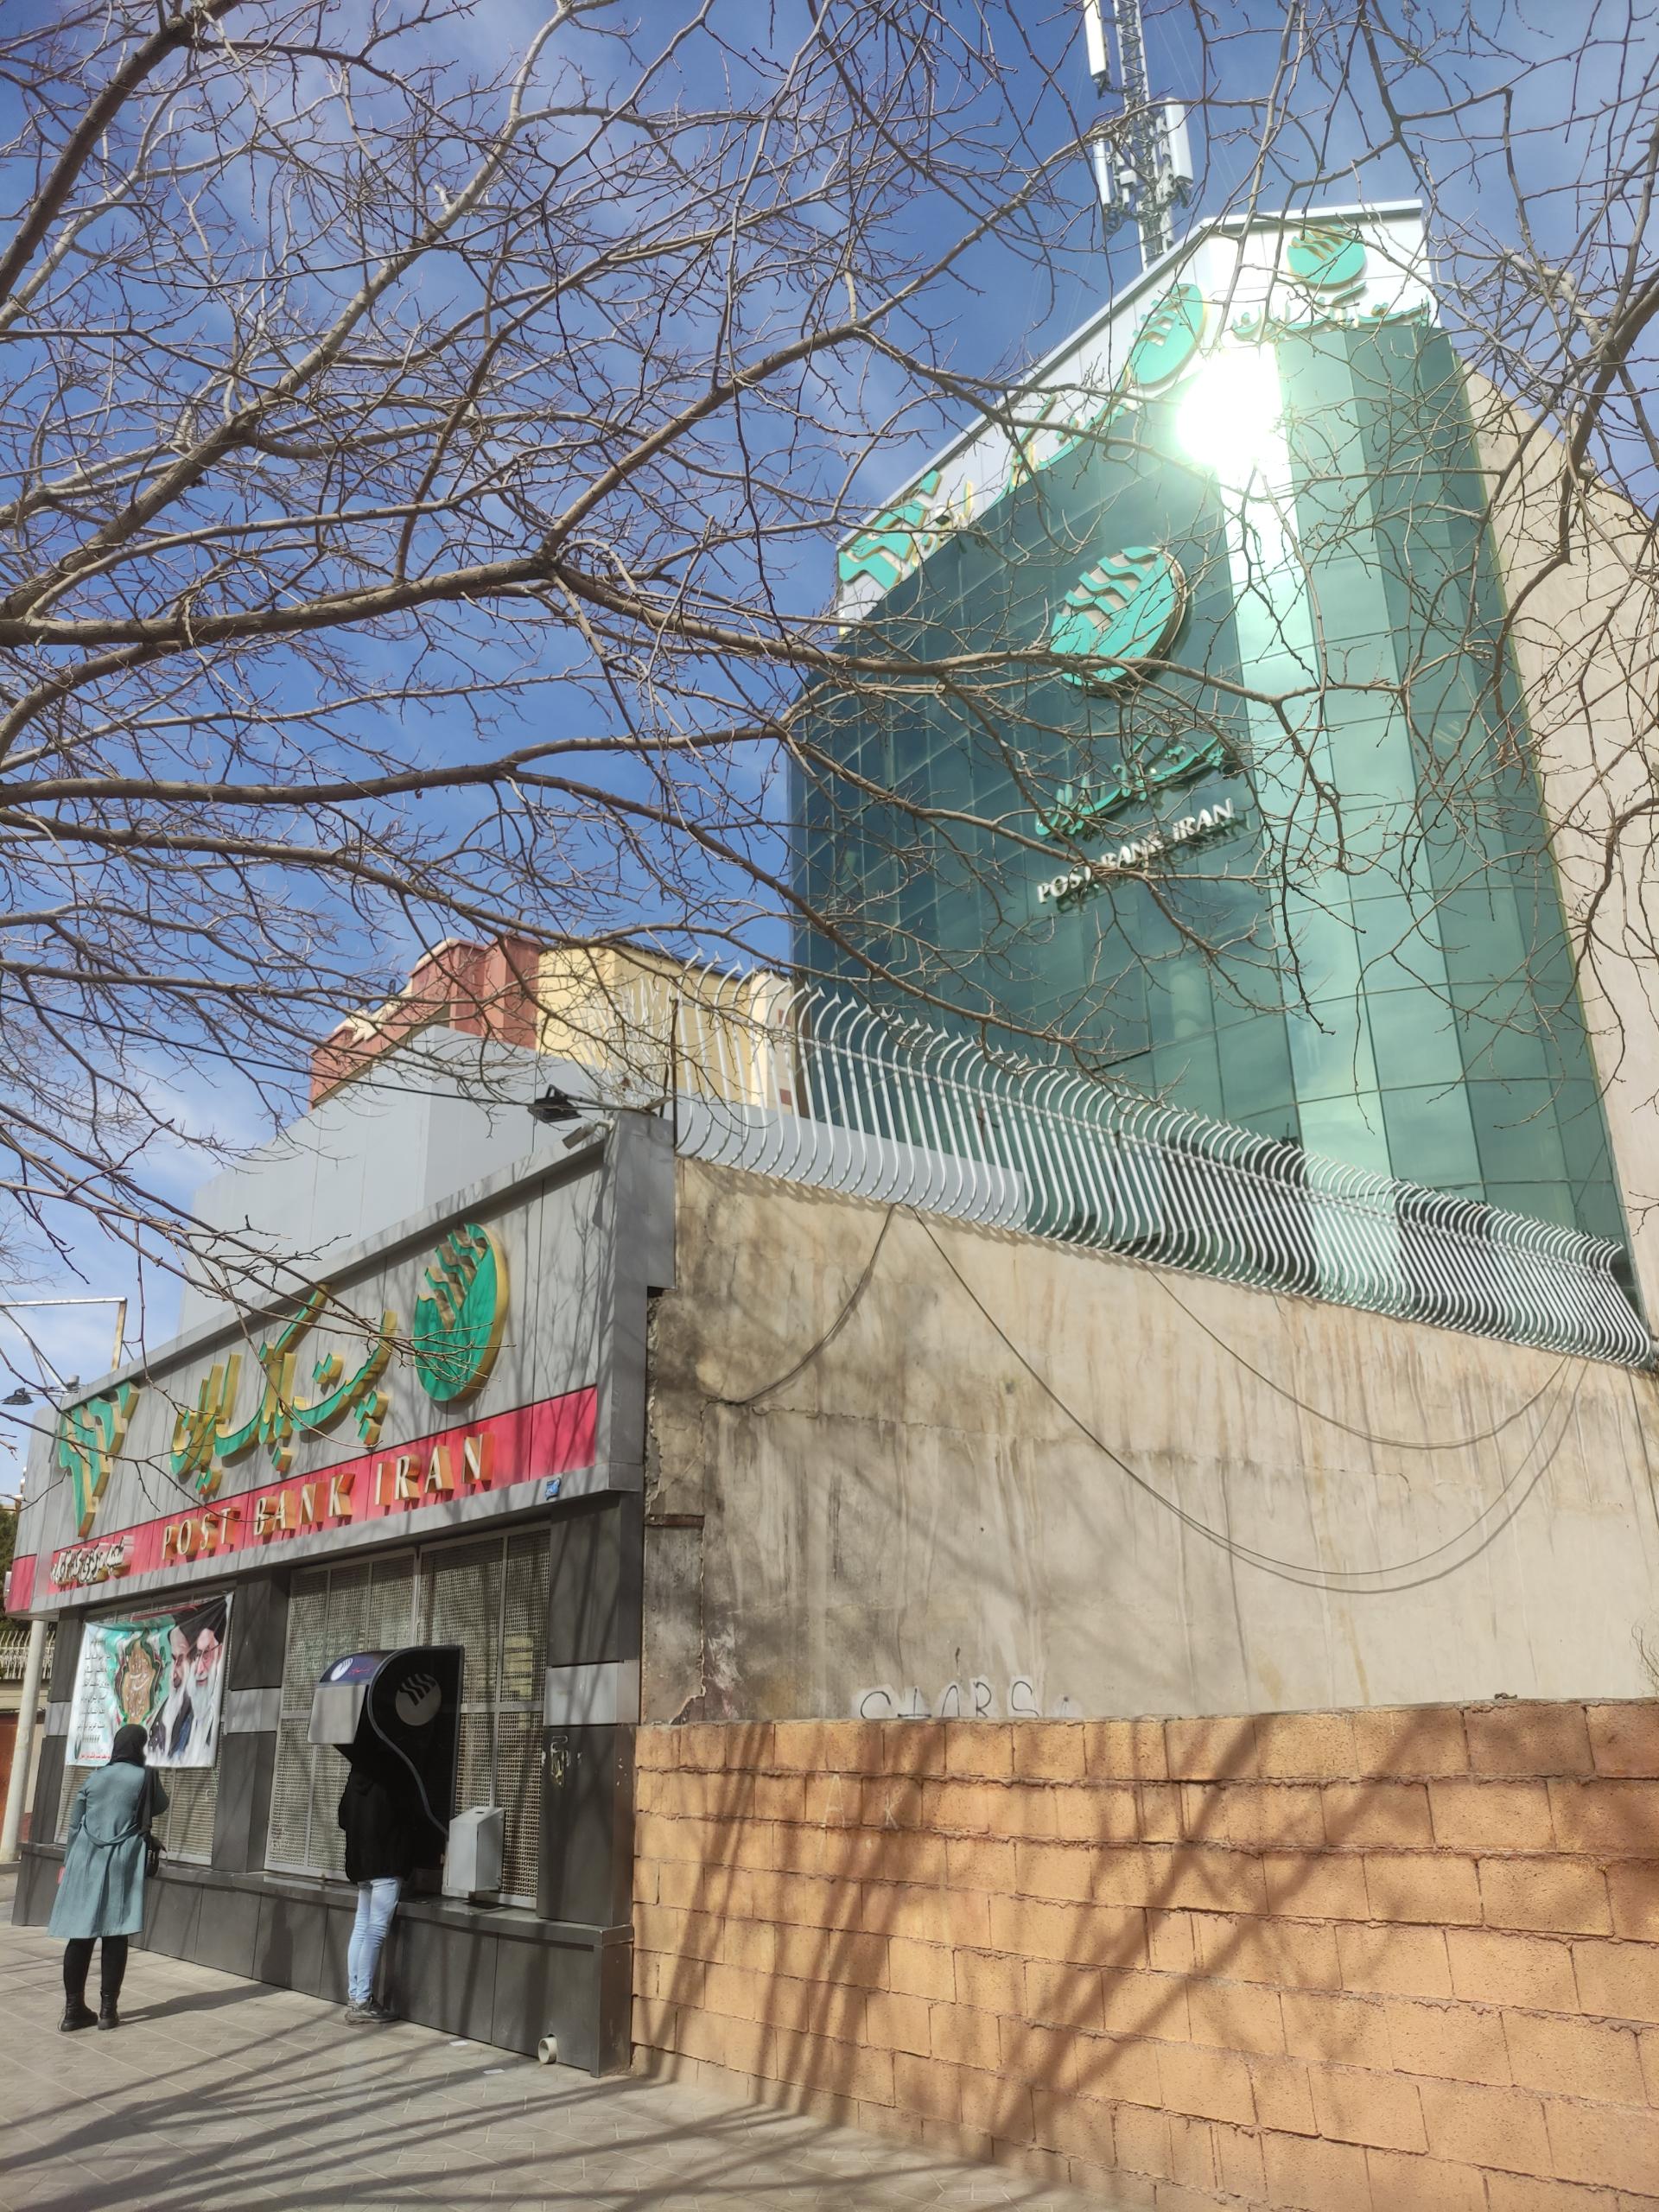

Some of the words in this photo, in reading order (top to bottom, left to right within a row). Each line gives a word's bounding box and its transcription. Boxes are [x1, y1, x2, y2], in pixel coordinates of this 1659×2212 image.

[1173, 798, 1235, 842] IRAN
[169, 1353, 242, 1495] ایران
[213, 1282, 332, 1472] بانک
[290, 1309, 397, 1448] پست
[162, 1506, 239, 1560] POST
[254, 1472, 355, 1536] BANK
[375, 1433, 495, 1507] IRAN
